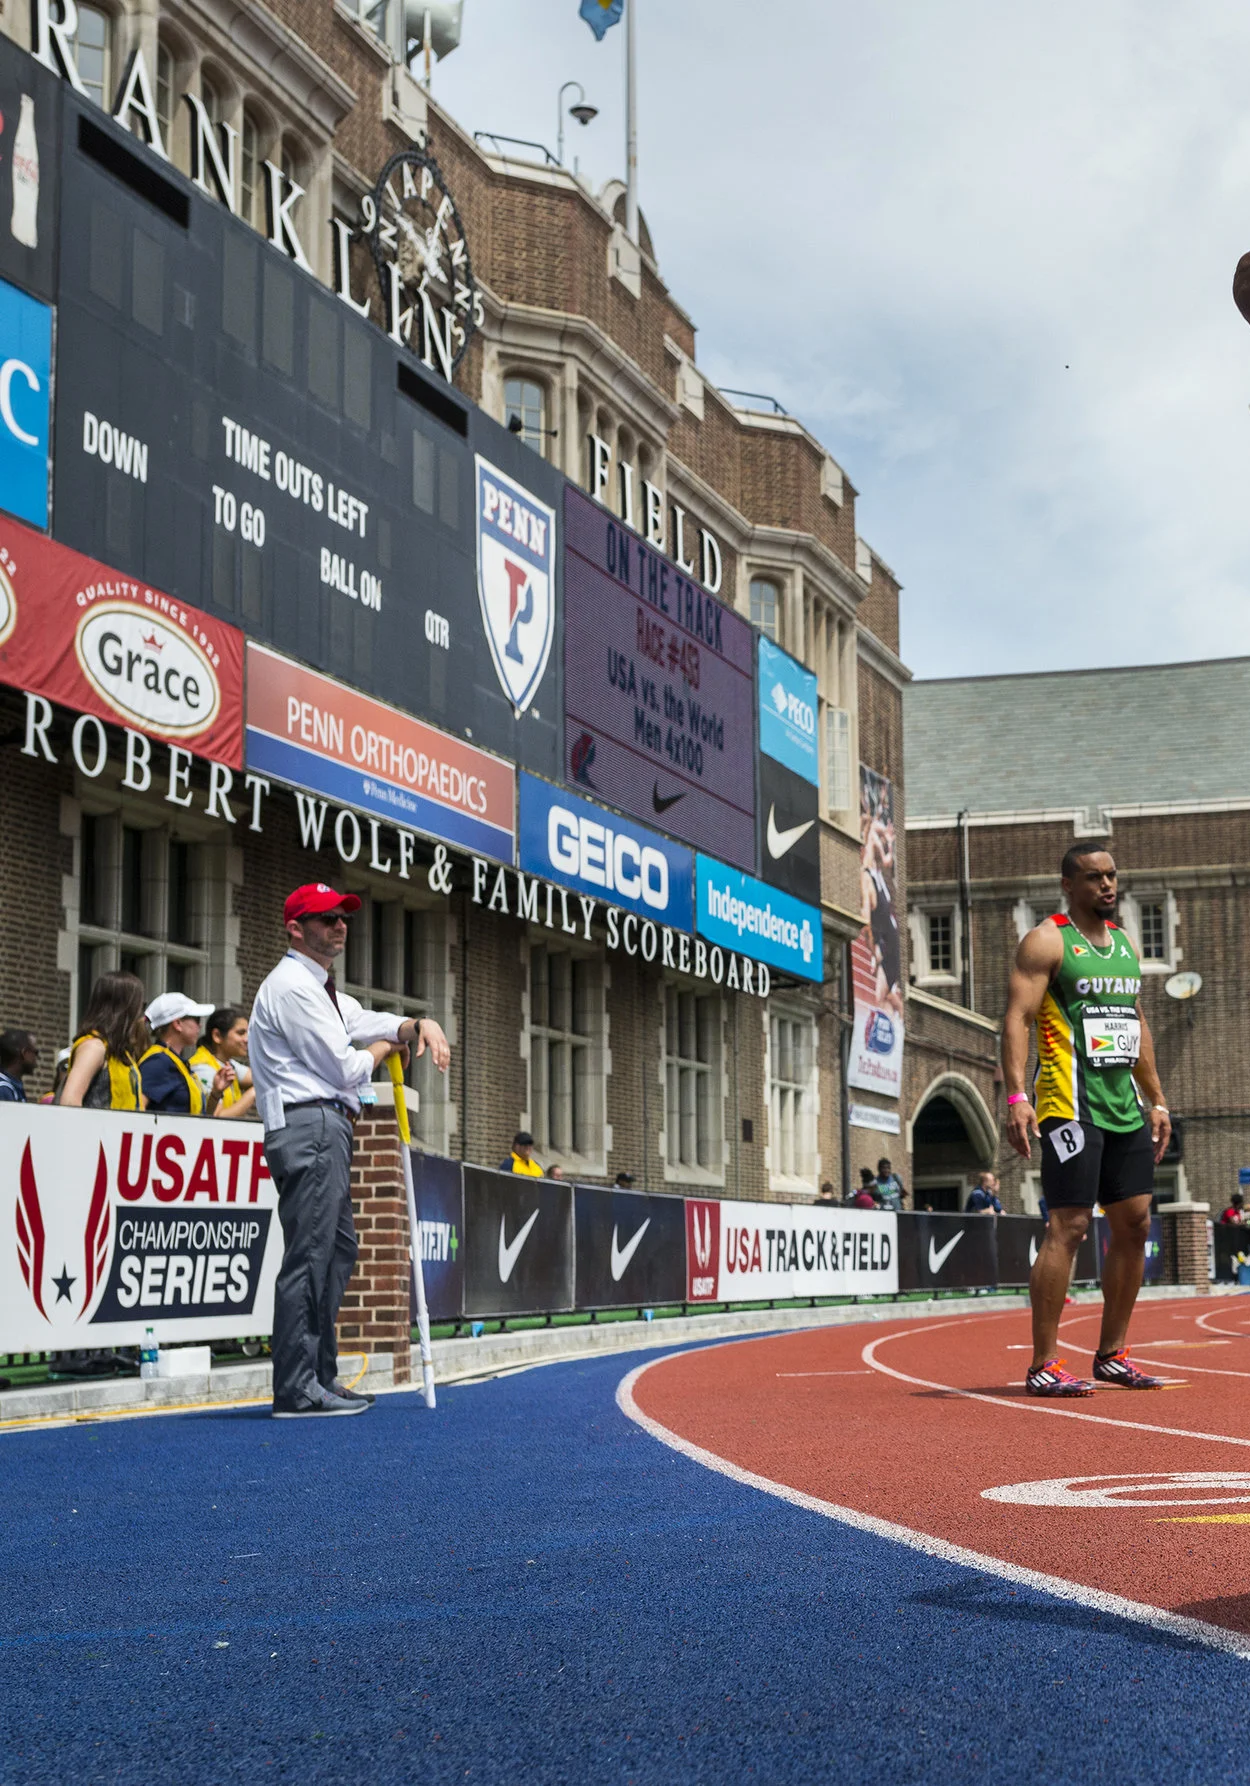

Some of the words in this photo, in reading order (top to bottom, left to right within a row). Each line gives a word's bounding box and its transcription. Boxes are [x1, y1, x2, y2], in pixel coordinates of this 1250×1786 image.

[83, 411, 149, 483] DOWN
[222, 416, 271, 481] TIME
[275, 450, 324, 512] OUTS
[327, 482, 369, 538] LEFT
[212, 484, 237, 531] TO
[240, 501, 266, 547] GO
[482, 478, 548, 558] PENN
[587, 433, 724, 594] FIELD
[320, 546, 359, 600] BALL
[360, 570, 382, 612] ON
[606, 521, 631, 586] ON
[636, 542, 670, 615] THE
[675, 574, 724, 653] TRACK
[75, 581, 140, 607] QUALITY
[144, 588, 189, 627] SINCE
[192, 624, 221, 669] 1922
[424, 609, 450, 651] QTR
[636, 605, 666, 670] RACE
[98, 631, 200, 709] Grace
[607, 645, 638, 699] USA
[663, 682, 685, 727] the
[687, 697, 725, 751] World
[633, 704, 663, 753] Men
[664, 725, 704, 777] 4x100
[787, 692, 815, 735] PECO
[286, 695, 345, 755] PENN
[350, 725, 488, 815] ORTHOPAEDICS
[20, 691, 271, 833] ROBERT
[295, 791, 416, 880] WOLF
[428, 843, 454, 895] &
[471, 856, 598, 942] FAMILY
[606, 906, 771, 999] SCOREBOARD
[547, 804, 669, 911] GEICO
[707, 879, 799, 951] Independence
[1104, 1022, 1128, 1031] HARRIS
[1117, 1034, 1139, 1052] GUY
[1060, 1128, 1077, 1154] 8
[118, 1218, 261, 1252] CHAMPIONSHIP
[725, 1227, 763, 1275] USA
[842, 1231, 891, 1271] FIELD
[116, 1253, 251, 1309] SERIES
